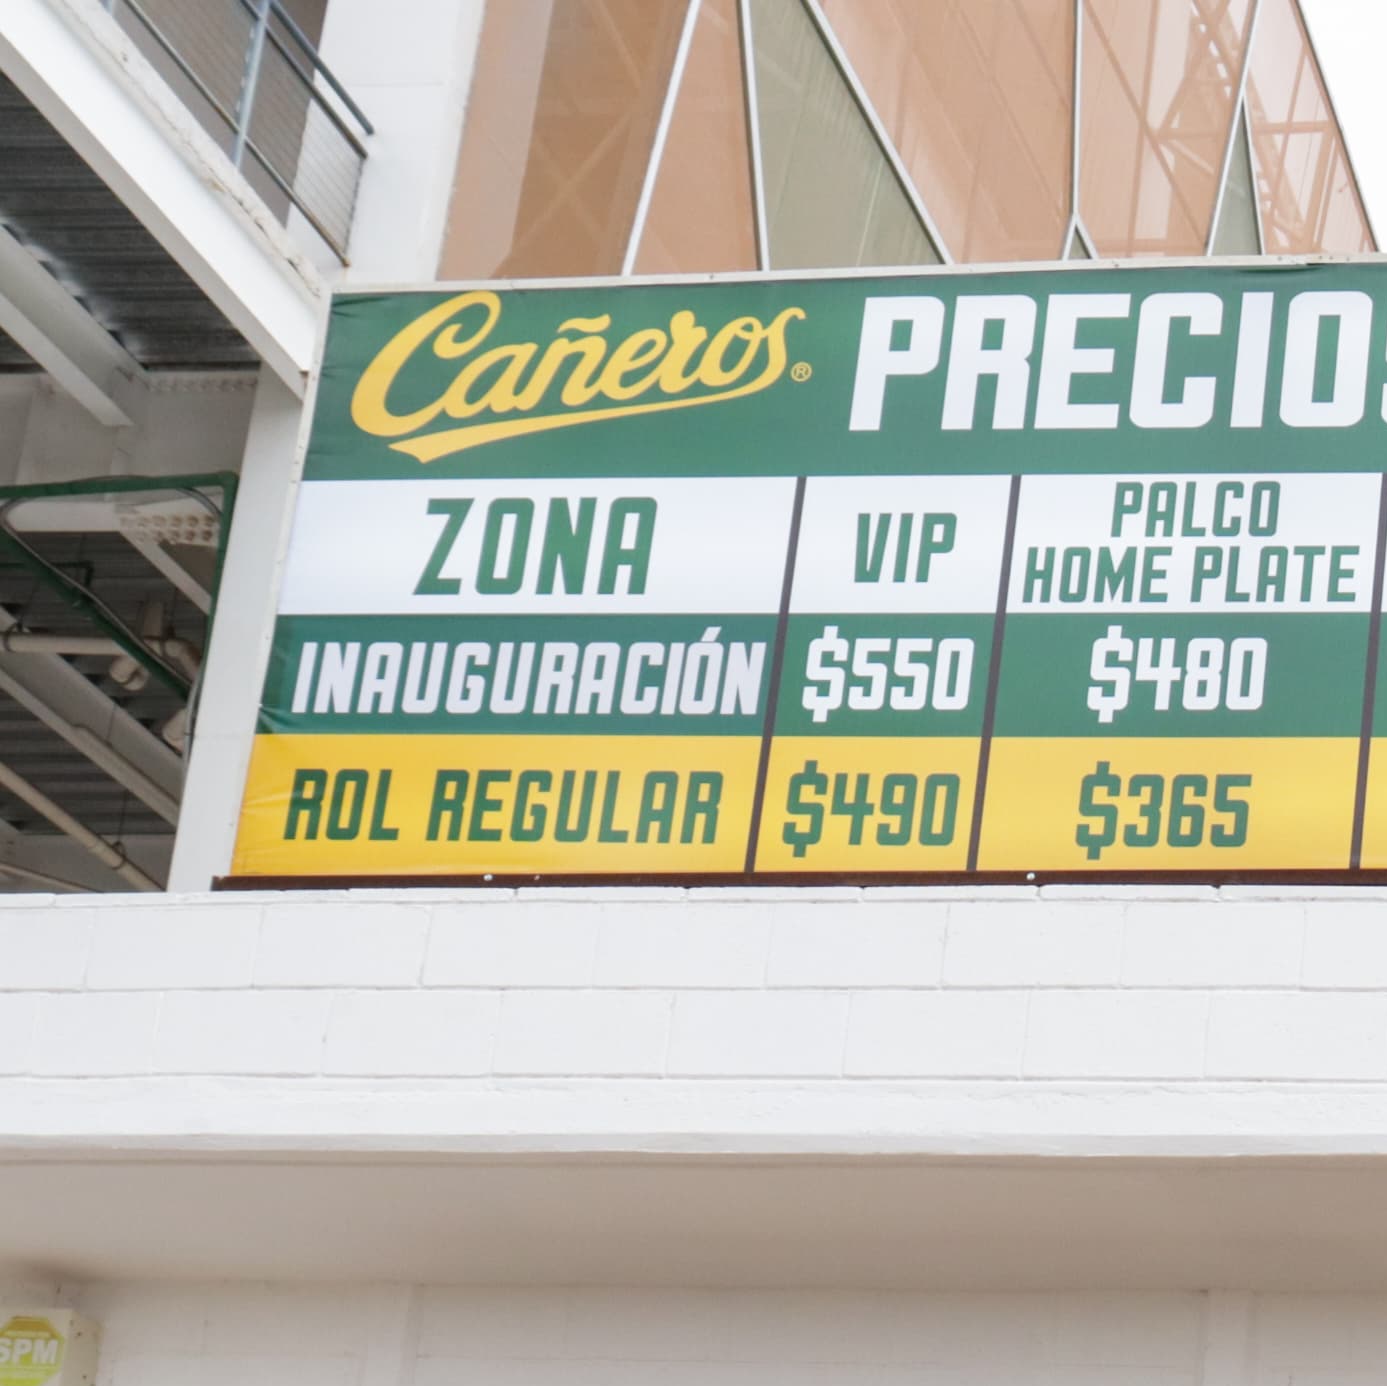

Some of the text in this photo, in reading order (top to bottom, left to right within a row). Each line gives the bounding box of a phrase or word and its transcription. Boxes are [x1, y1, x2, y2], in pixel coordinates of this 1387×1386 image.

[414, 497, 657, 595] ZONA
[855, 513, 957, 583] VIP
[1111, 481, 1280, 537] PALCO
[1023, 546, 1359, 603] HOME PLATE
[292, 627, 766, 715] INAUGURACIÓN
[802, 626, 974, 722] $550
[1087, 626, 1267, 723] $480
[284, 769, 723, 844] ROL REGULAR
[783, 761, 960, 857] $490
[1076, 762, 1251, 860] $365
